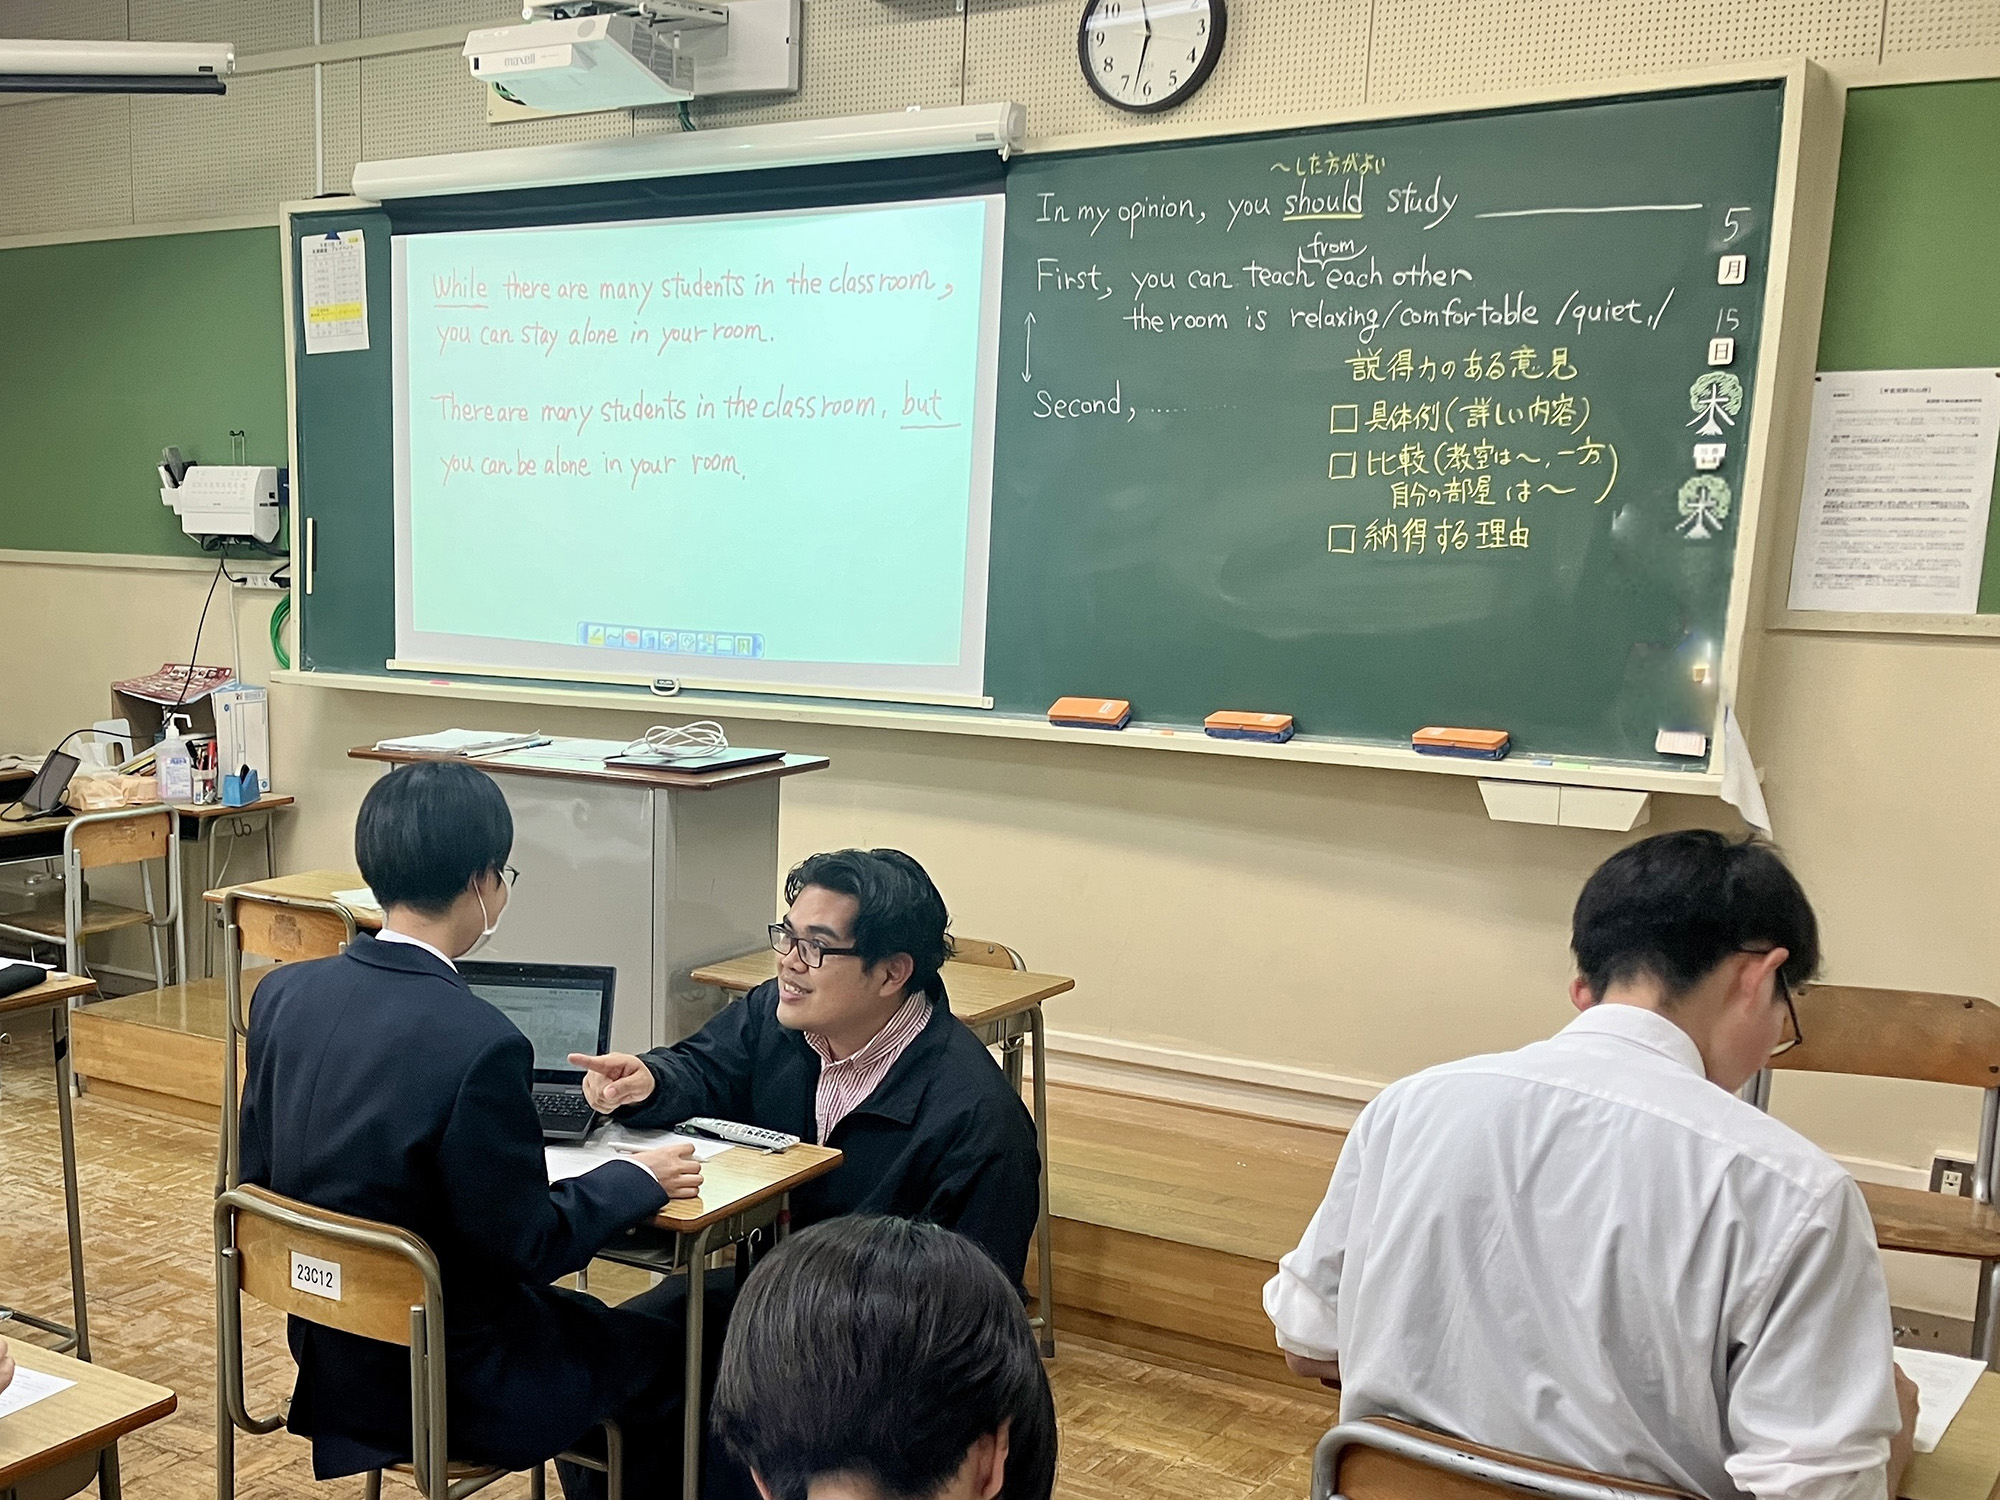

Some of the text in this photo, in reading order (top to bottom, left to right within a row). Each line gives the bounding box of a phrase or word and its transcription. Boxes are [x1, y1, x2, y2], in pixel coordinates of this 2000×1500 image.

[1104, 2, 1121, 19] 10
[1096, 31, 1106, 48] 9
[1196, 18, 1206, 36] 3
[504, 53, 536, 67] maxell
[1103, 56, 1114, 73] 8
[1186, 46, 1196, 64] 4
[1121, 75, 1130, 92] 7
[1142, 80, 1151, 97] 6
[1168, 70, 1177, 87] 5
[1036, 174, 1459, 239] In my opinion, you should study
[1307, 231, 1355, 258] from
[432, 266, 489, 299] While
[502, 270, 551, 300] there
[557, 281, 590, 300] are
[599, 280, 654, 316] many
[661, 267, 745, 299] students
[754, 272, 774, 297] in
[786, 262, 822, 295] the
[1036, 253, 1473, 301] First, you can teach each other
[1713, 206, 1751, 362] 5 月 15 日
[1122, 302, 1164, 333] the
[1169, 311, 1228, 332] room
[1246, 306, 1268, 331] is
[437, 315, 775, 358] you can stay alone in your room.
[1345, 344, 1579, 384] 説得力のある意見
[430, 390, 494, 422] There
[497, 404, 530, 423] are
[541, 404, 594, 437] many
[600, 388, 688, 423] students
[696, 392, 715, 419] in
[722, 385, 759, 419] the
[902, 379, 943, 421] but
[1032, 378, 1137, 423] Second,
[440, 444, 746, 492] you can be alone in your room.
[1363, 516, 1530, 555] 納得する理由
[297, 1264, 333, 1288] 23C12
